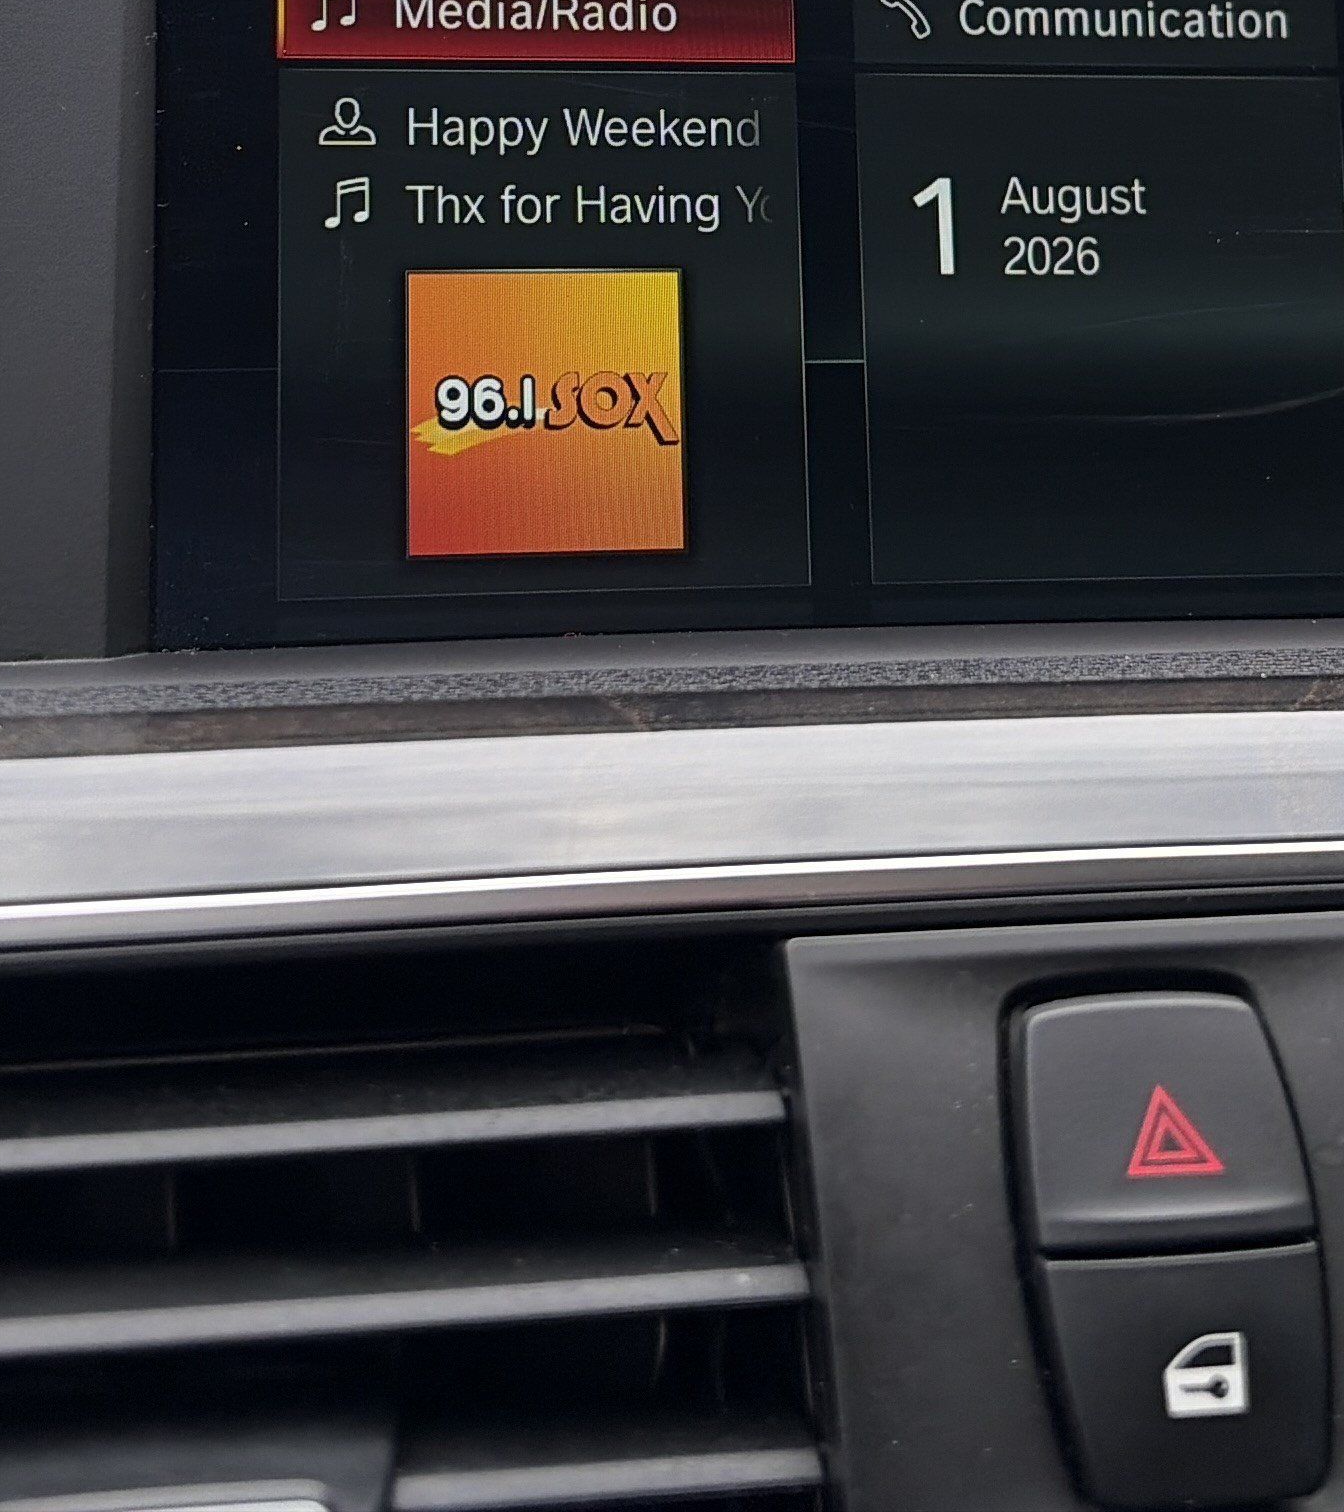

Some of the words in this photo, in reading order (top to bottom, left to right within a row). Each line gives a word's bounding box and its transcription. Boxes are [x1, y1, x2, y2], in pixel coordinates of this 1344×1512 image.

[408, 107, 549, 156] Happy
[562, 107, 759, 148] Weekend
[404, 185, 486, 224] Thx
[500, 184, 561, 224] for
[576, 184, 720, 233] Having
[1000, 176, 1147, 224] August
[912, 177, 955, 275] 1
[1003, 236, 1100, 276] 2026
[435, 374, 537, 431] 96.1
[544, 371, 680, 446] SOX
